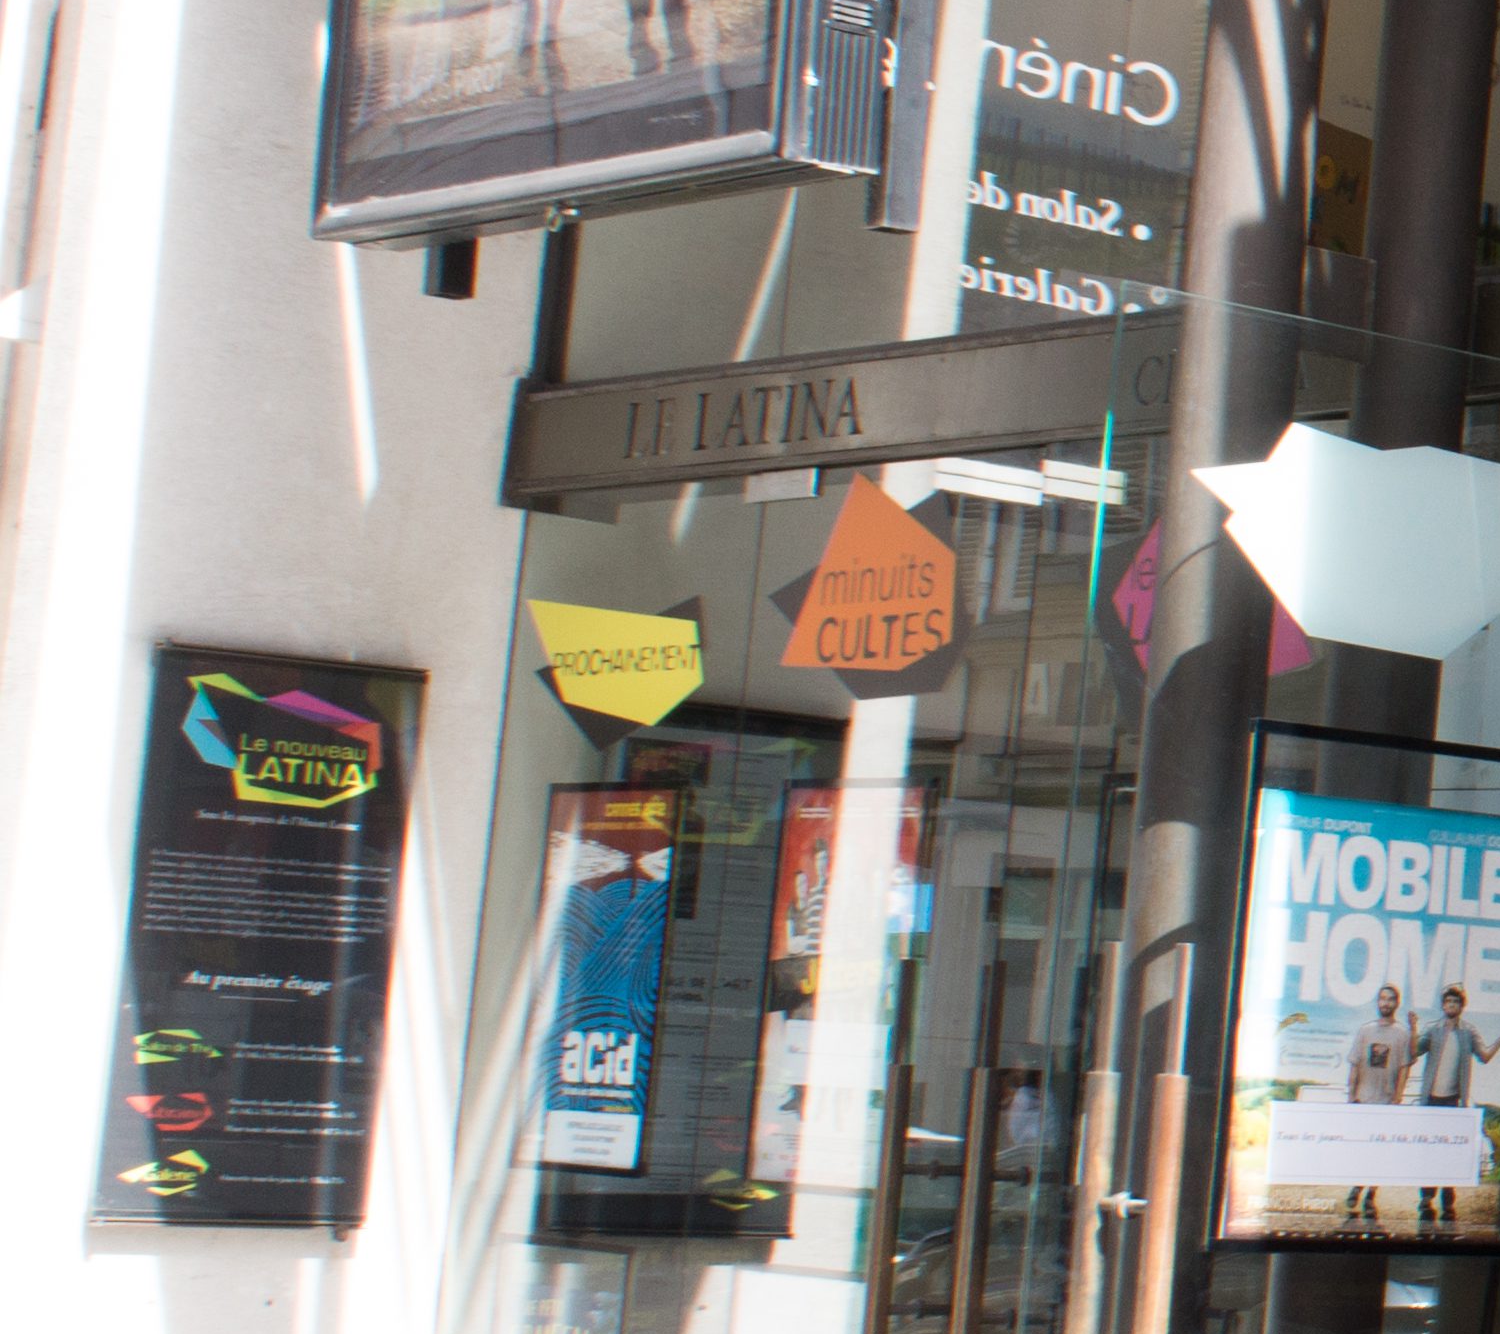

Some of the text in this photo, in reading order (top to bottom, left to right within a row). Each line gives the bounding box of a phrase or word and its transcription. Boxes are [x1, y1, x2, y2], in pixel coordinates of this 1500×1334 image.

[692, 377, 864, 452] LATINA
[820, 555, 934, 606] minuits
[816, 609, 944, 664] CULTES
[236, 753, 365, 790] LATINA
[239, 732, 367, 763] Le nouveau
[1324, 819, 1372, 834] DUPONT
[561, 1031, 640, 1085] acid
